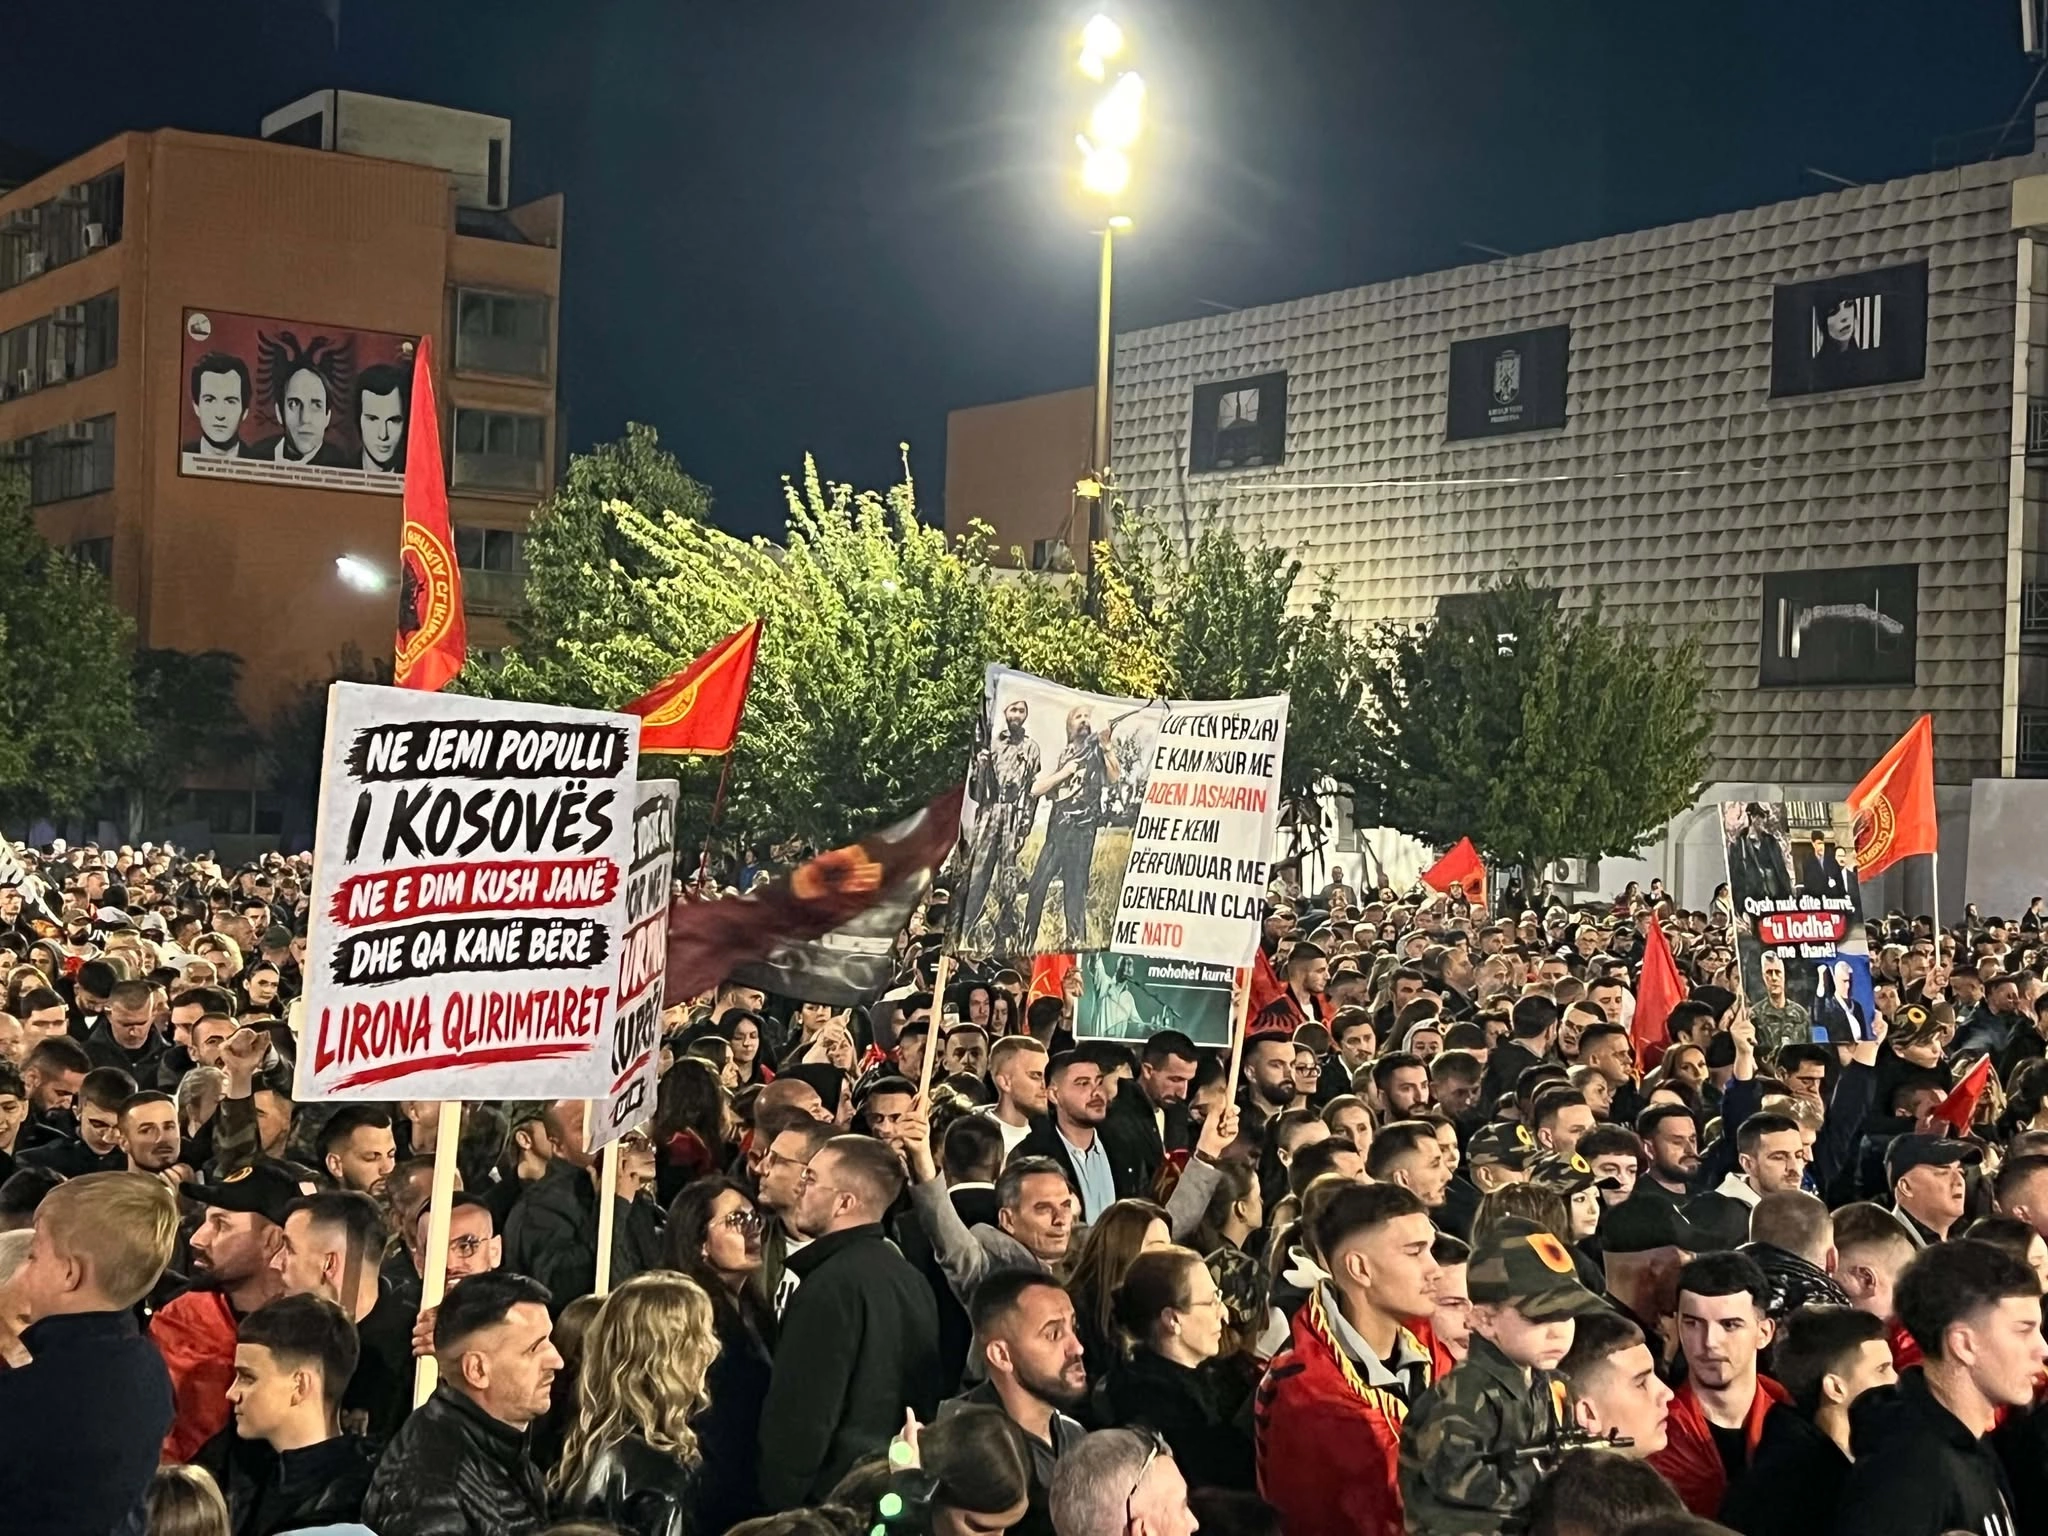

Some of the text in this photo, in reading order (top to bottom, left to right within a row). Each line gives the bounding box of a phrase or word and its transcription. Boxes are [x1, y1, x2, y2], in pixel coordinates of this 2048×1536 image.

[366, 728, 615, 774] NE JEMI POPULLI
[1155, 746, 1167, 769] E
[1167, 747, 1201, 772] KAM
[1249, 753, 1275, 778] ME
[1145, 782, 1267, 813] ADEM JASHARIN
[344, 788, 373, 864] I
[382, 779, 617, 864] KOSOVËS
[1137, 816, 1220, 843] DHE E KEMI
[1128, 847, 1266, 885] PËRFUNDUAR ME
[348, 879, 388, 920] NE
[393, 876, 412, 912] E
[417, 867, 466, 908] DIM
[471, 866, 539, 906] KUSH
[542, 860, 609, 902] JANË
[1122, 885, 1217, 915] GJENERALIN
[1744, 896, 1775, 916] Qysh
[1776, 896, 1798, 912] nuk
[349, 935, 406, 979] DHE
[411, 929, 447, 970] QA
[453, 921, 524, 964] KANË
[528, 921, 595, 963] BËRË
[1115, 920, 1183, 948] ME NATO
[1777, 945, 1796, 959] me
[314, 985, 610, 1075] LIRONA QLIRIMTARET
